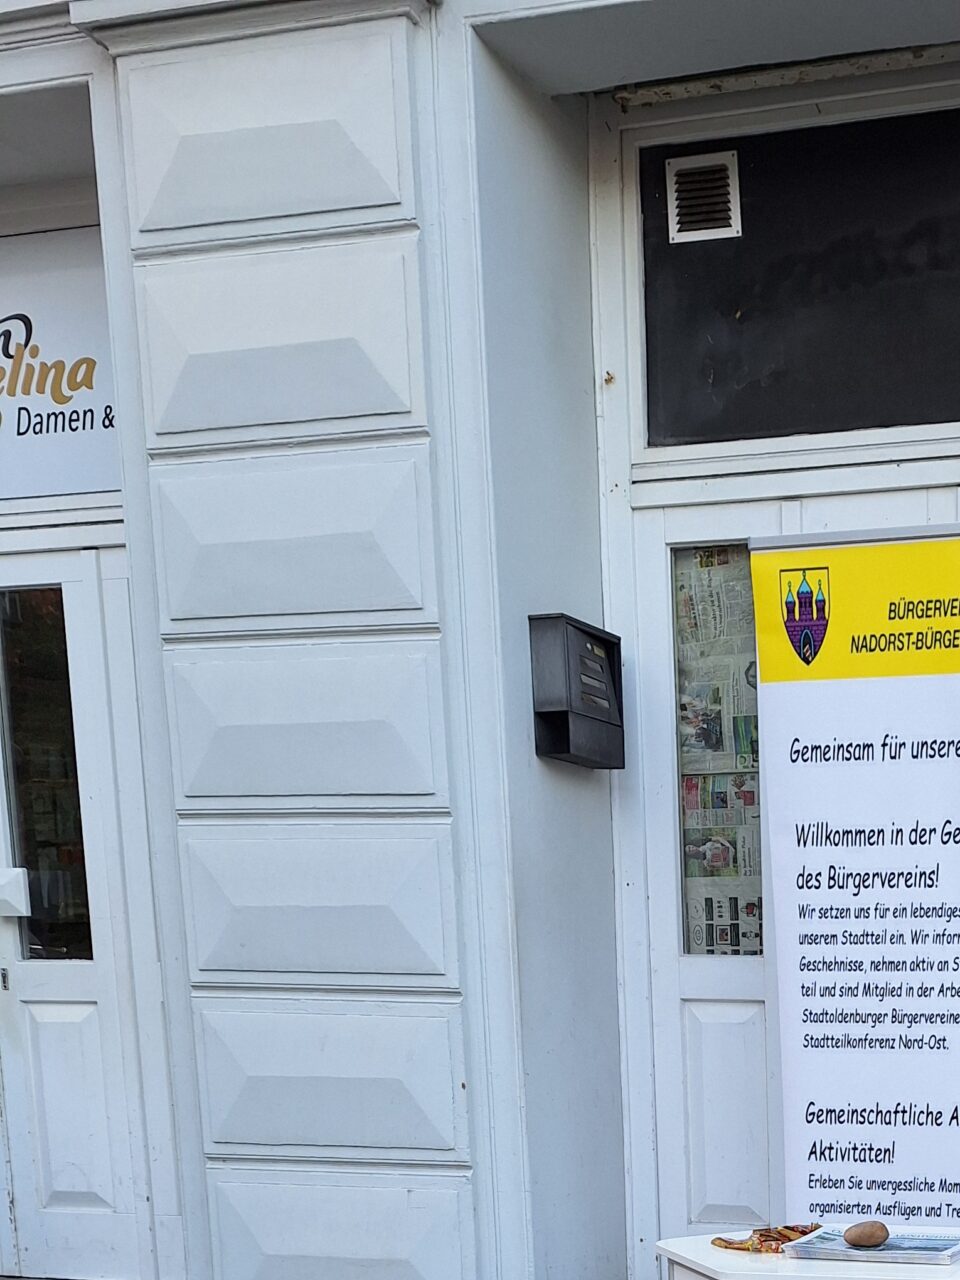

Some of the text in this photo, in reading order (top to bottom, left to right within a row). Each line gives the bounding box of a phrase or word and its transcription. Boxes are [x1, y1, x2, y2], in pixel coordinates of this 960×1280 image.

[16, 404, 115, 436] Damen &
[790, 738, 874, 763] Gemeinsam
[881, 734, 906, 761] für
[796, 822, 884, 848] Willkommen
[891, 822, 903, 845] in
[909, 820, 936, 845] der
[797, 863, 939, 896] des Bürgervereins!
[798, 904, 816, 919] Wir
[818, 905, 850, 919] setzen
[854, 907, 870, 919] uns
[874, 902, 890, 919] für
[893, 904, 907, 918] ein
[799, 934, 837, 945] unserem
[841, 929, 887, 945] Stadtteil
[890, 930, 906, 945] ein.
[911, 929, 929, 944] Wir
[800, 956, 866, 974] Geschehnisse,
[870, 956, 907, 972] nehmen
[910, 956, 934, 971] aktiv
[937, 961, 948, 971] an
[801, 981, 816, 997] teil
[820, 982, 836, 997] und
[839, 982, 859, 997] sind
[862, 982, 902, 1002] Mitglied
[906, 983, 914, 997] in
[917, 982, 934, 997] der
[802, 1008, 888, 1028] Stadtoldenburger
[891, 1008, 960, 1028] Bürgervereine
[803, 1033, 949, 1050] Stadtteilkonferenz Nord-Ost.
[806, 1102, 942, 1126] Gemeinschaftliche
[808, 1139, 895, 1163] Aktivitäten!
[809, 1174, 845, 1189] Erleben
[848, 1176, 863, 1190] Sie
[866, 1177, 935, 1195] unvergessliche
[809, 1202, 871, 1217] organisierten
[875, 1201, 922, 1220] Ausflügen
[925, 1203, 942, 1217] und
